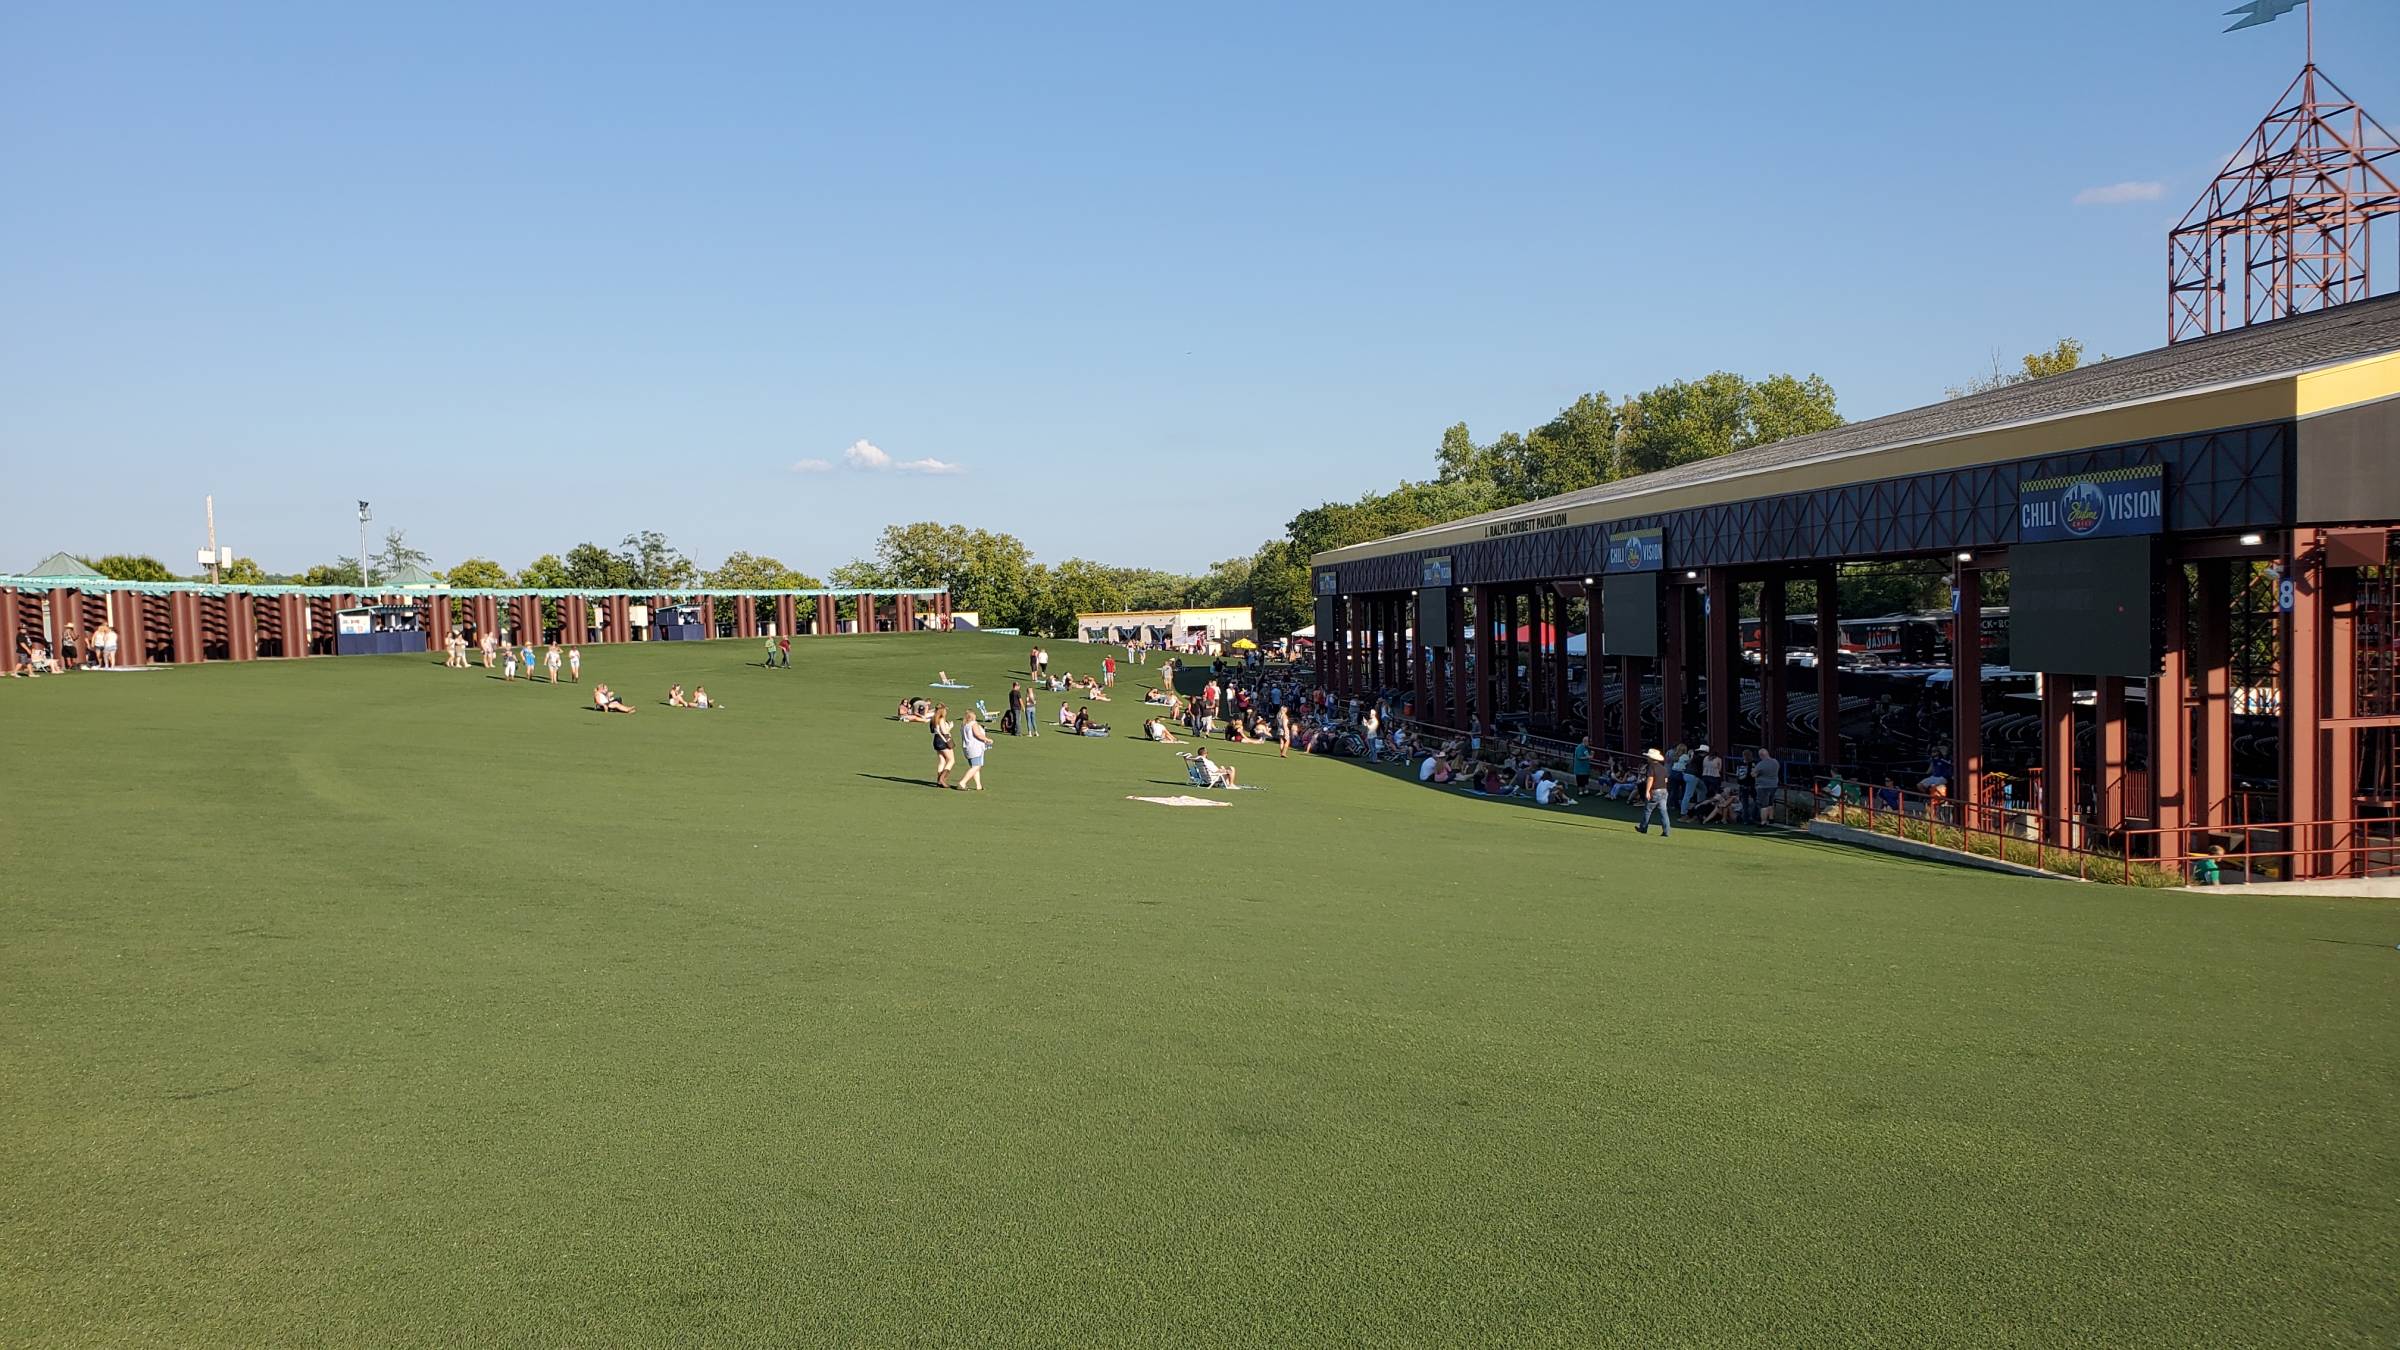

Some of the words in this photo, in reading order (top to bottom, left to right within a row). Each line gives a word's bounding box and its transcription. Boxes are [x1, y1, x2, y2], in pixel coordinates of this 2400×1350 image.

[2022, 500, 2057, 528] CHILI
[2108, 489, 2161, 520] VISION
[1490, 523, 1508, 537] RALPH
[1509, 518, 1535, 534] CORBETT
[1536, 512, 1567, 529] PAVILION
[1610, 547, 1625, 564] CHILI
[1642, 543, 1662, 561] VISION
[1952, 589, 1960, 611] 7
[2280, 580, 2294, 609] 8
[1866, 631, 1893, 650] JASON
